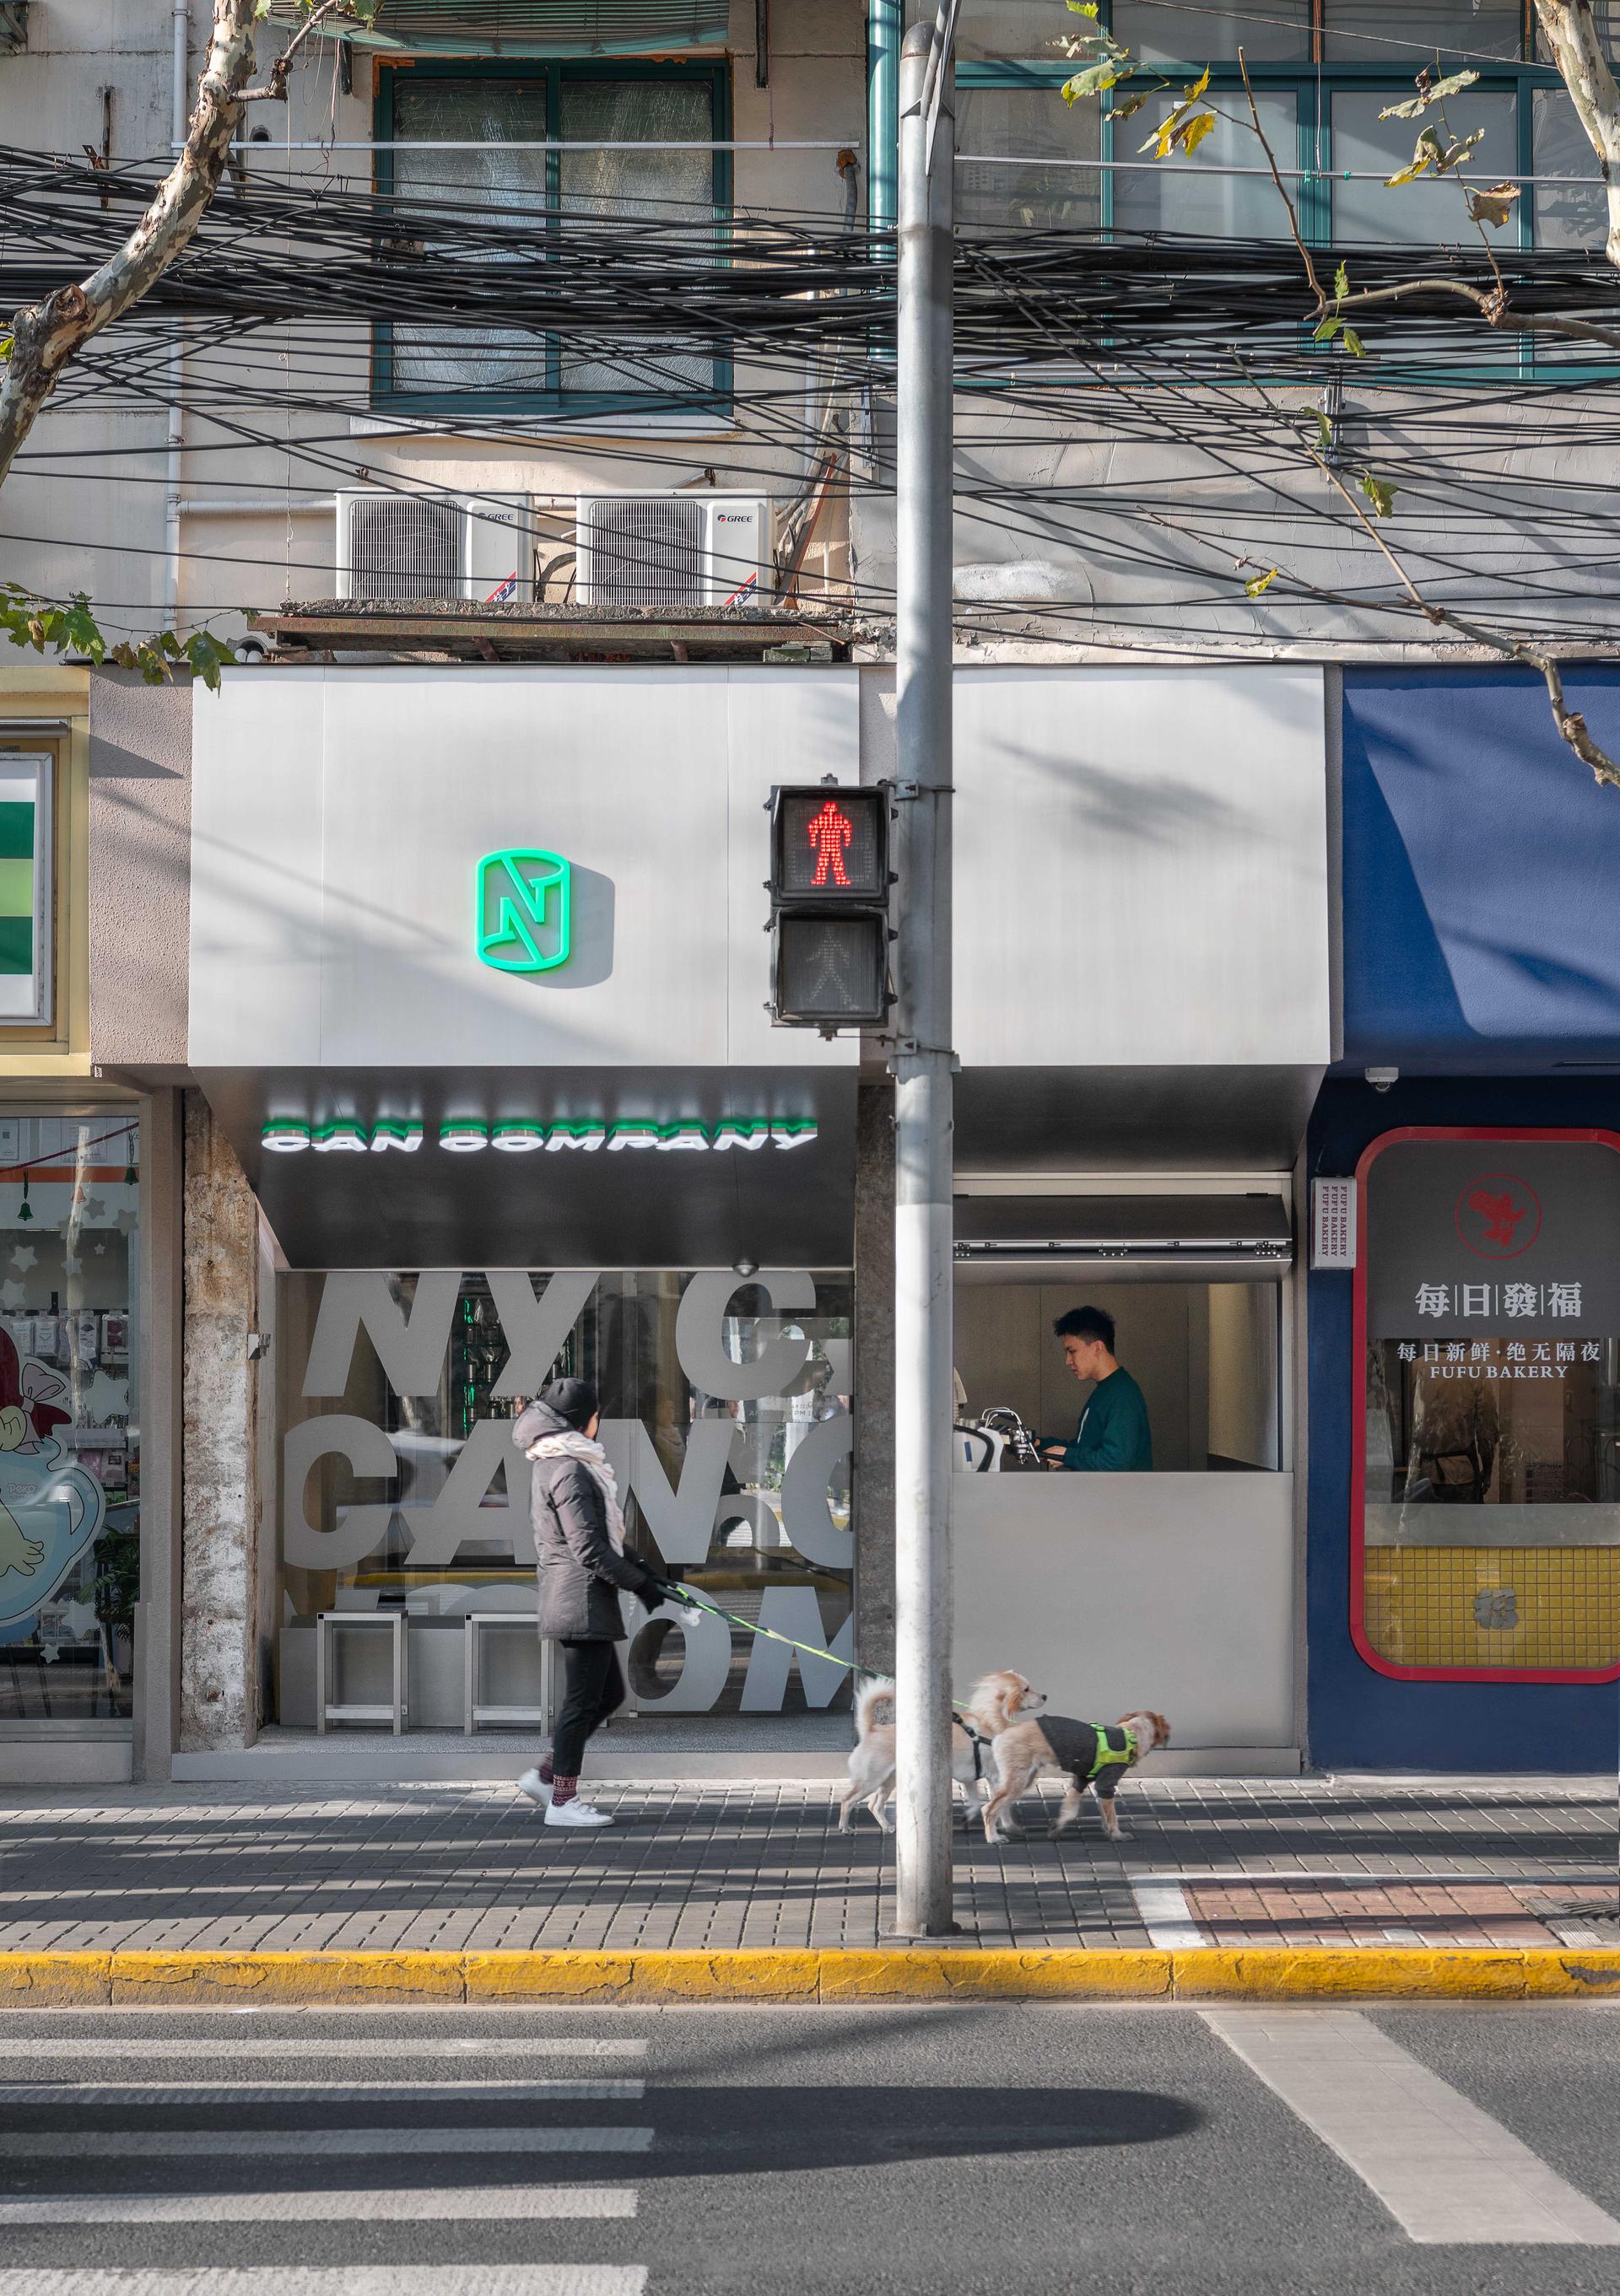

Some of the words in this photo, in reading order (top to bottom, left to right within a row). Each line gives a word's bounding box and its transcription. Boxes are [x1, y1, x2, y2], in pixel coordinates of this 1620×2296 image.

[262, 1124, 424, 1153] CAN
[439, 1124, 818, 1153] COMPANY
[1414, 1281, 1583, 1318] 每日發福
[1429, 1366, 1482, 1379] FUFU
[1485, 1366, 1569, 1379] BAKERY
[284, 1414, 736, 1571] CAN
